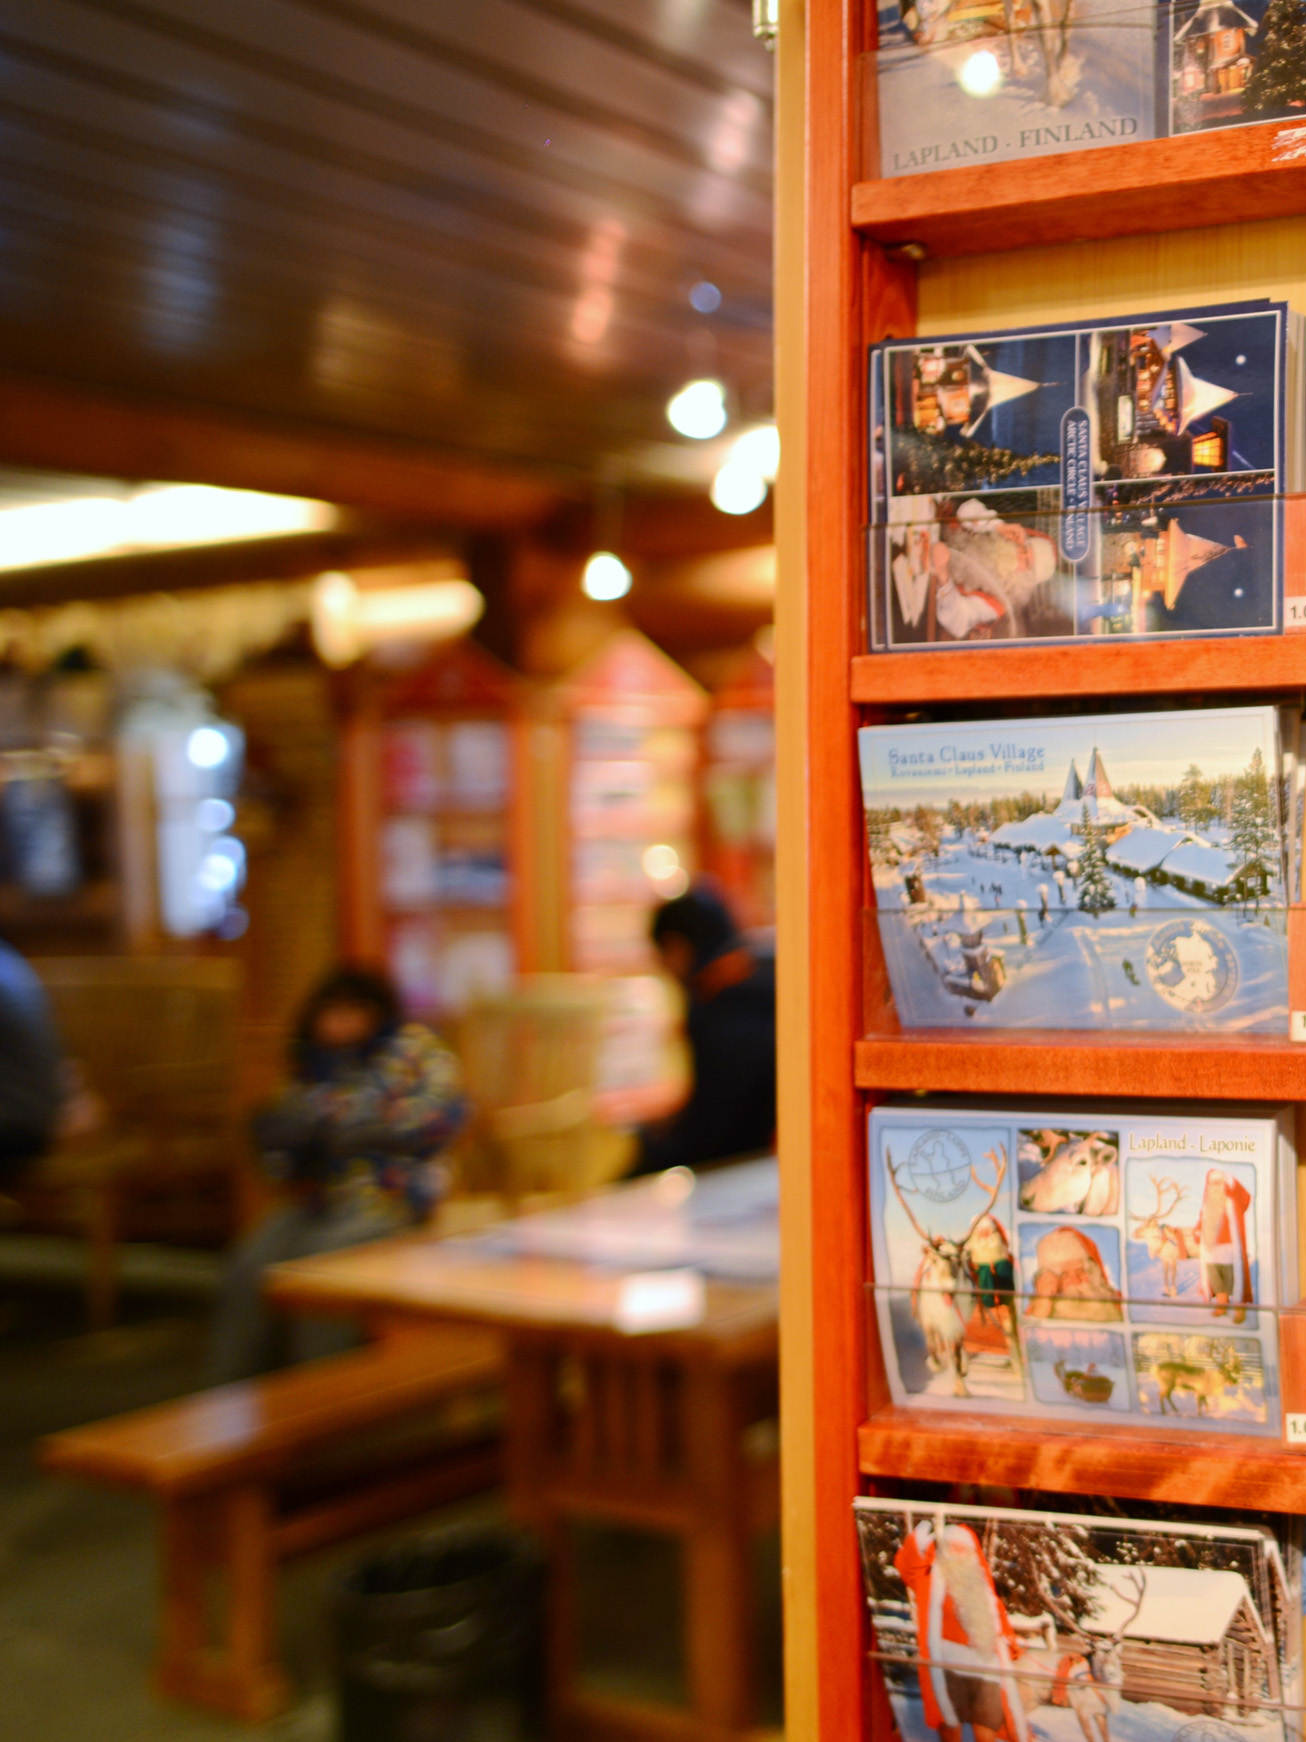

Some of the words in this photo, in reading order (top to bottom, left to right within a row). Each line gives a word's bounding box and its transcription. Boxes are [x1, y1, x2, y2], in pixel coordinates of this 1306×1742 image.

[892, 135, 999, 171] LAPLAND
[1018, 117, 1139, 148] FINLAND
[1066, 419, 1077, 458] ARCTIC
[1077, 419, 1088, 459] SANTA
[1066, 459, 1077, 497] CIRCLE
[1077, 460, 1088, 499] CLAUS
[887, 747, 935, 765] Santa
[939, 745, 986, 762] Claus
[989, 743, 1045, 763] Village
[955, 764, 995, 777] Lapland
[1004, 761, 1045, 773] Finland
[1129, 1132, 1186, 1152] Lapland
[1199, 1135, 1256, 1154] Laponie
